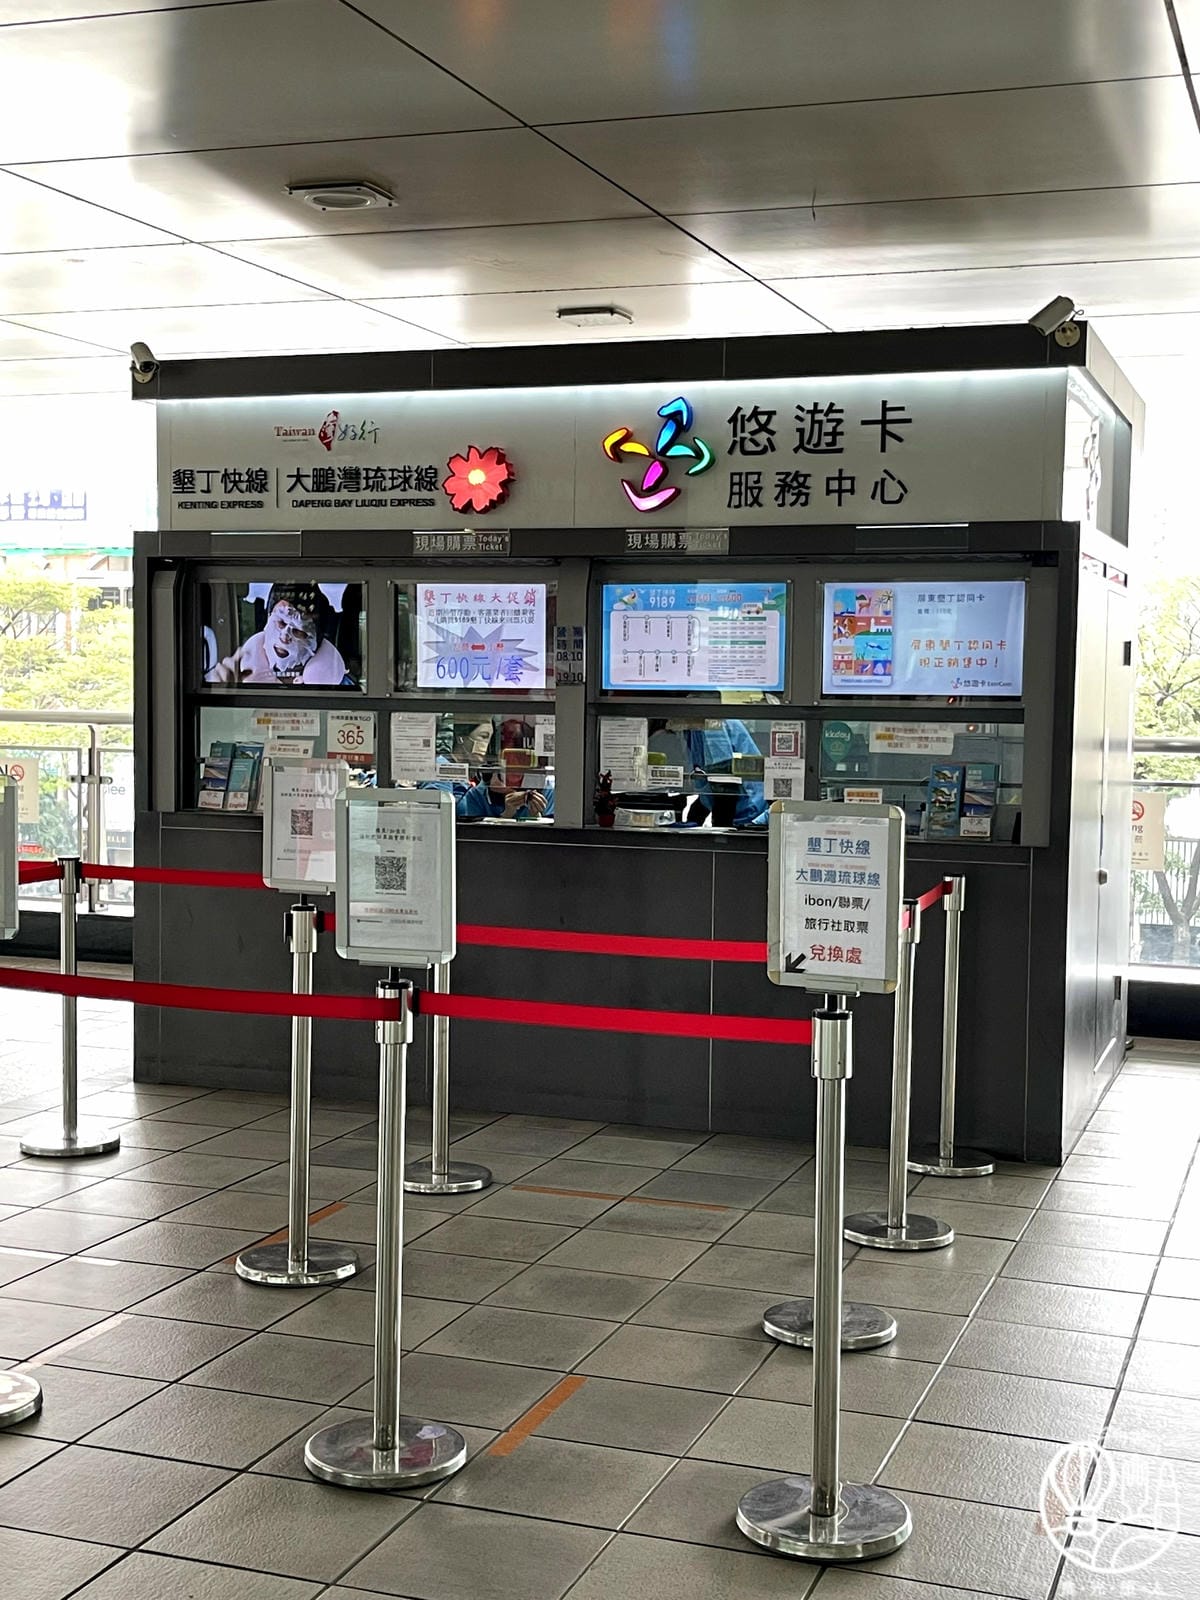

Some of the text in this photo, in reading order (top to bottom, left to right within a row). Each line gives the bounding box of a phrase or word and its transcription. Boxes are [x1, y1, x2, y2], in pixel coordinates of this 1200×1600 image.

[274, 426, 315, 437] Taiwan
[726, 400, 912, 456] 悠遊卡
[172, 467, 269, 494] 墾丁快線
[286, 464, 439, 493] 大鵬灣琉球線
[727, 468, 908, 508] 服務中心
[178, 500, 264, 509] KENTING EXPRESS
[292, 499, 332, 508] DAPENG
[334, 499, 353, 507] BAY
[389, 498, 435, 507] EXPRESS
[415, 535, 477, 551] 現場購票
[479, 534, 509, 543] Today's
[479, 543, 503, 551] Ticket
[627, 532, 689, 549] 現場購票
[424, 588, 537, 608] 墾丁快線大促銷
[649, 597, 676, 608] 9189
[436, 655, 524, 682] 600元/套
[337, 729, 364, 745] 365
[807, 837, 870, 855] 墾丁快線
[795, 868, 880, 886] 大鵬灣琉球線
[804, 894, 870, 911] ibon/聯票/
[804, 918, 869, 934] 旅行社取票
